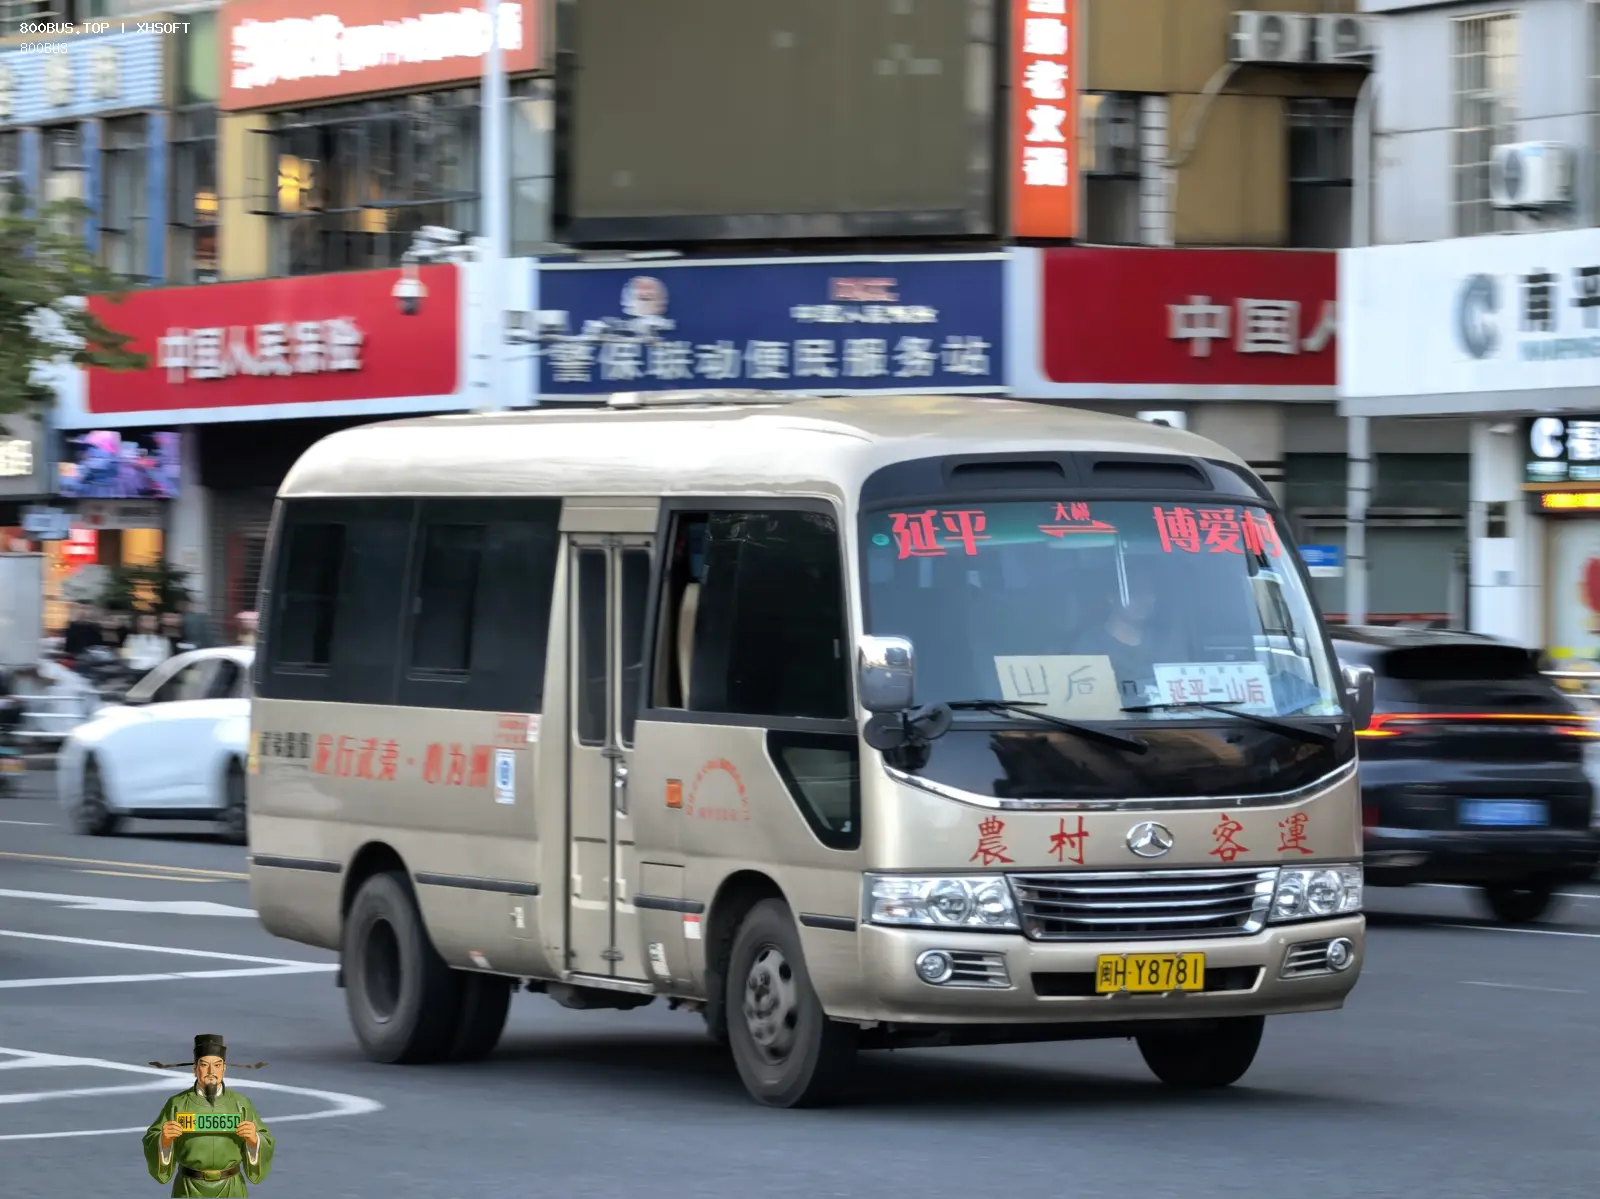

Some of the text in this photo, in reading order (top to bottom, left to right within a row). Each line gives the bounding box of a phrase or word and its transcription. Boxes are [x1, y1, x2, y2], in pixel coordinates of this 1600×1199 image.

[888, 509, 993, 560] 延平
[1152, 505, 1283, 558] 博爱村
[1008, 663, 1098, 703] 山后
